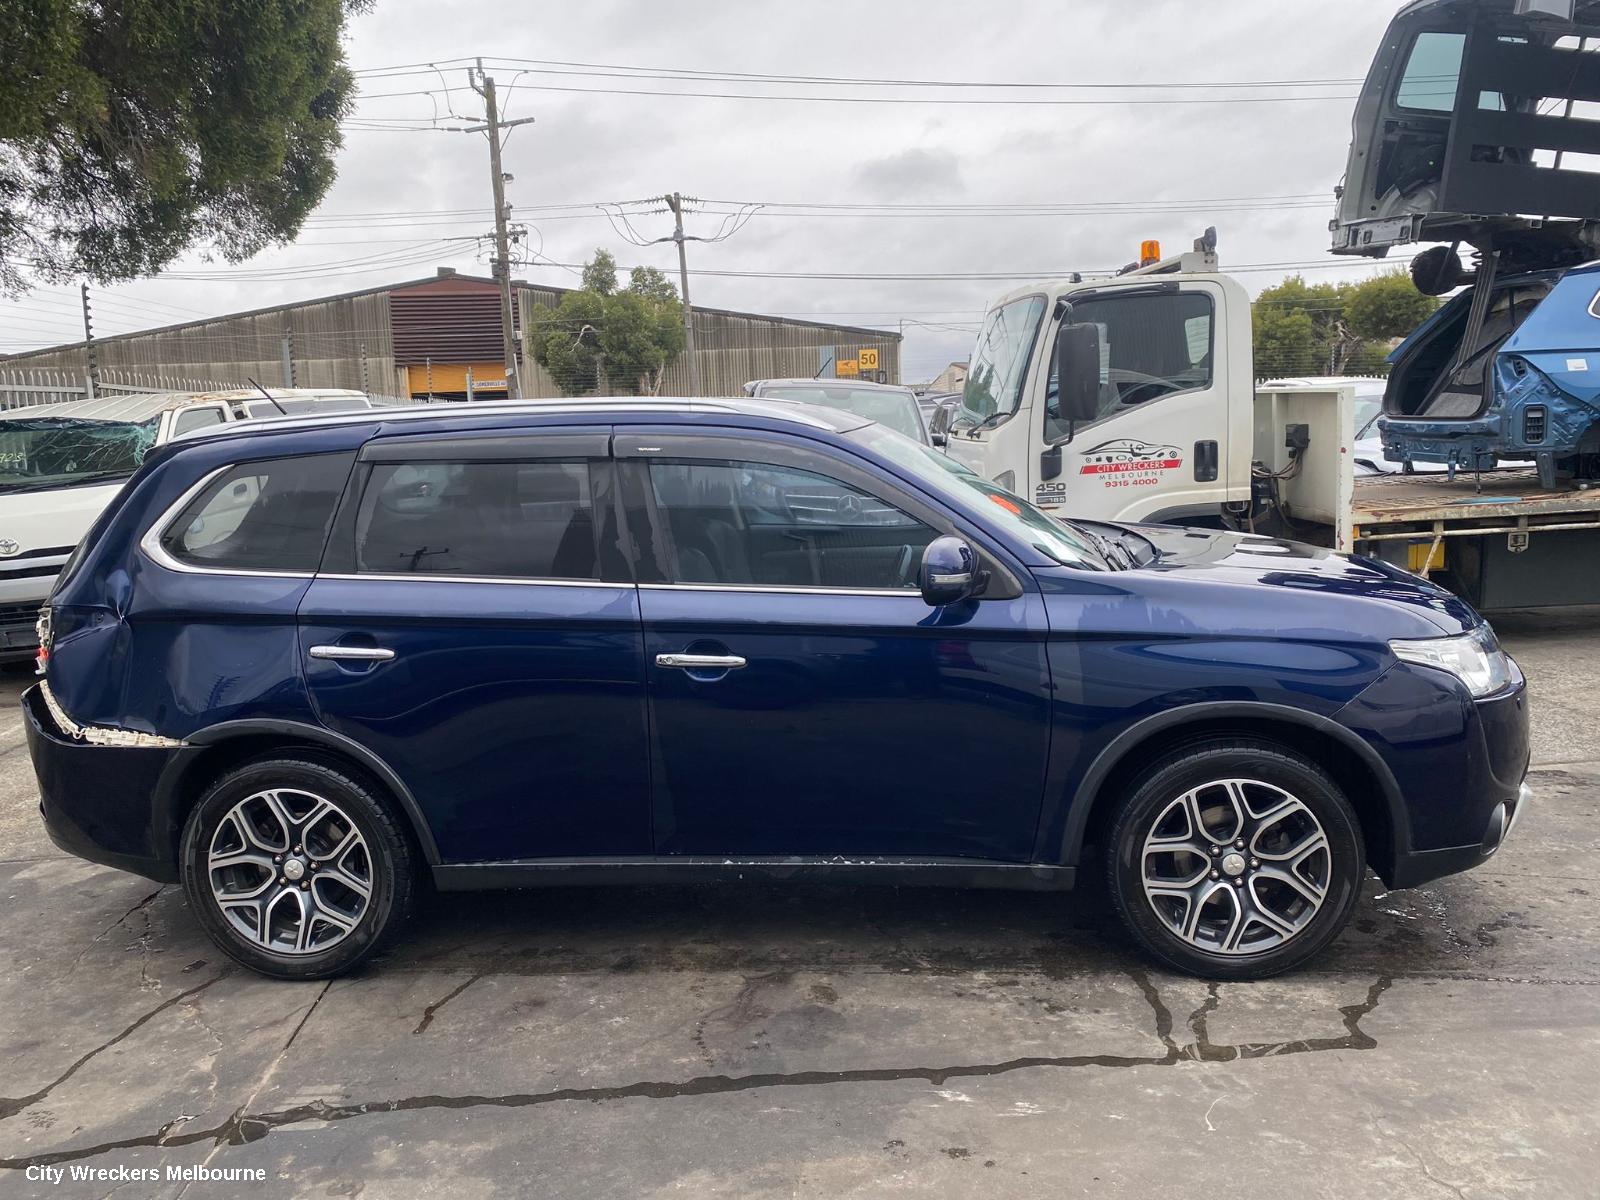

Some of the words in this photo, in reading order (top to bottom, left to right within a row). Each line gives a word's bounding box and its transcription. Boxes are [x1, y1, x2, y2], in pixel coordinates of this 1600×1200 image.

[861, 353, 876, 365] 50
[1096, 464, 1118, 473] CITY
[1119, 461, 1166, 471] WRECKERS
[1100, 471, 1164, 480] MELBOURNE
[1036, 483, 1066, 491] 450
